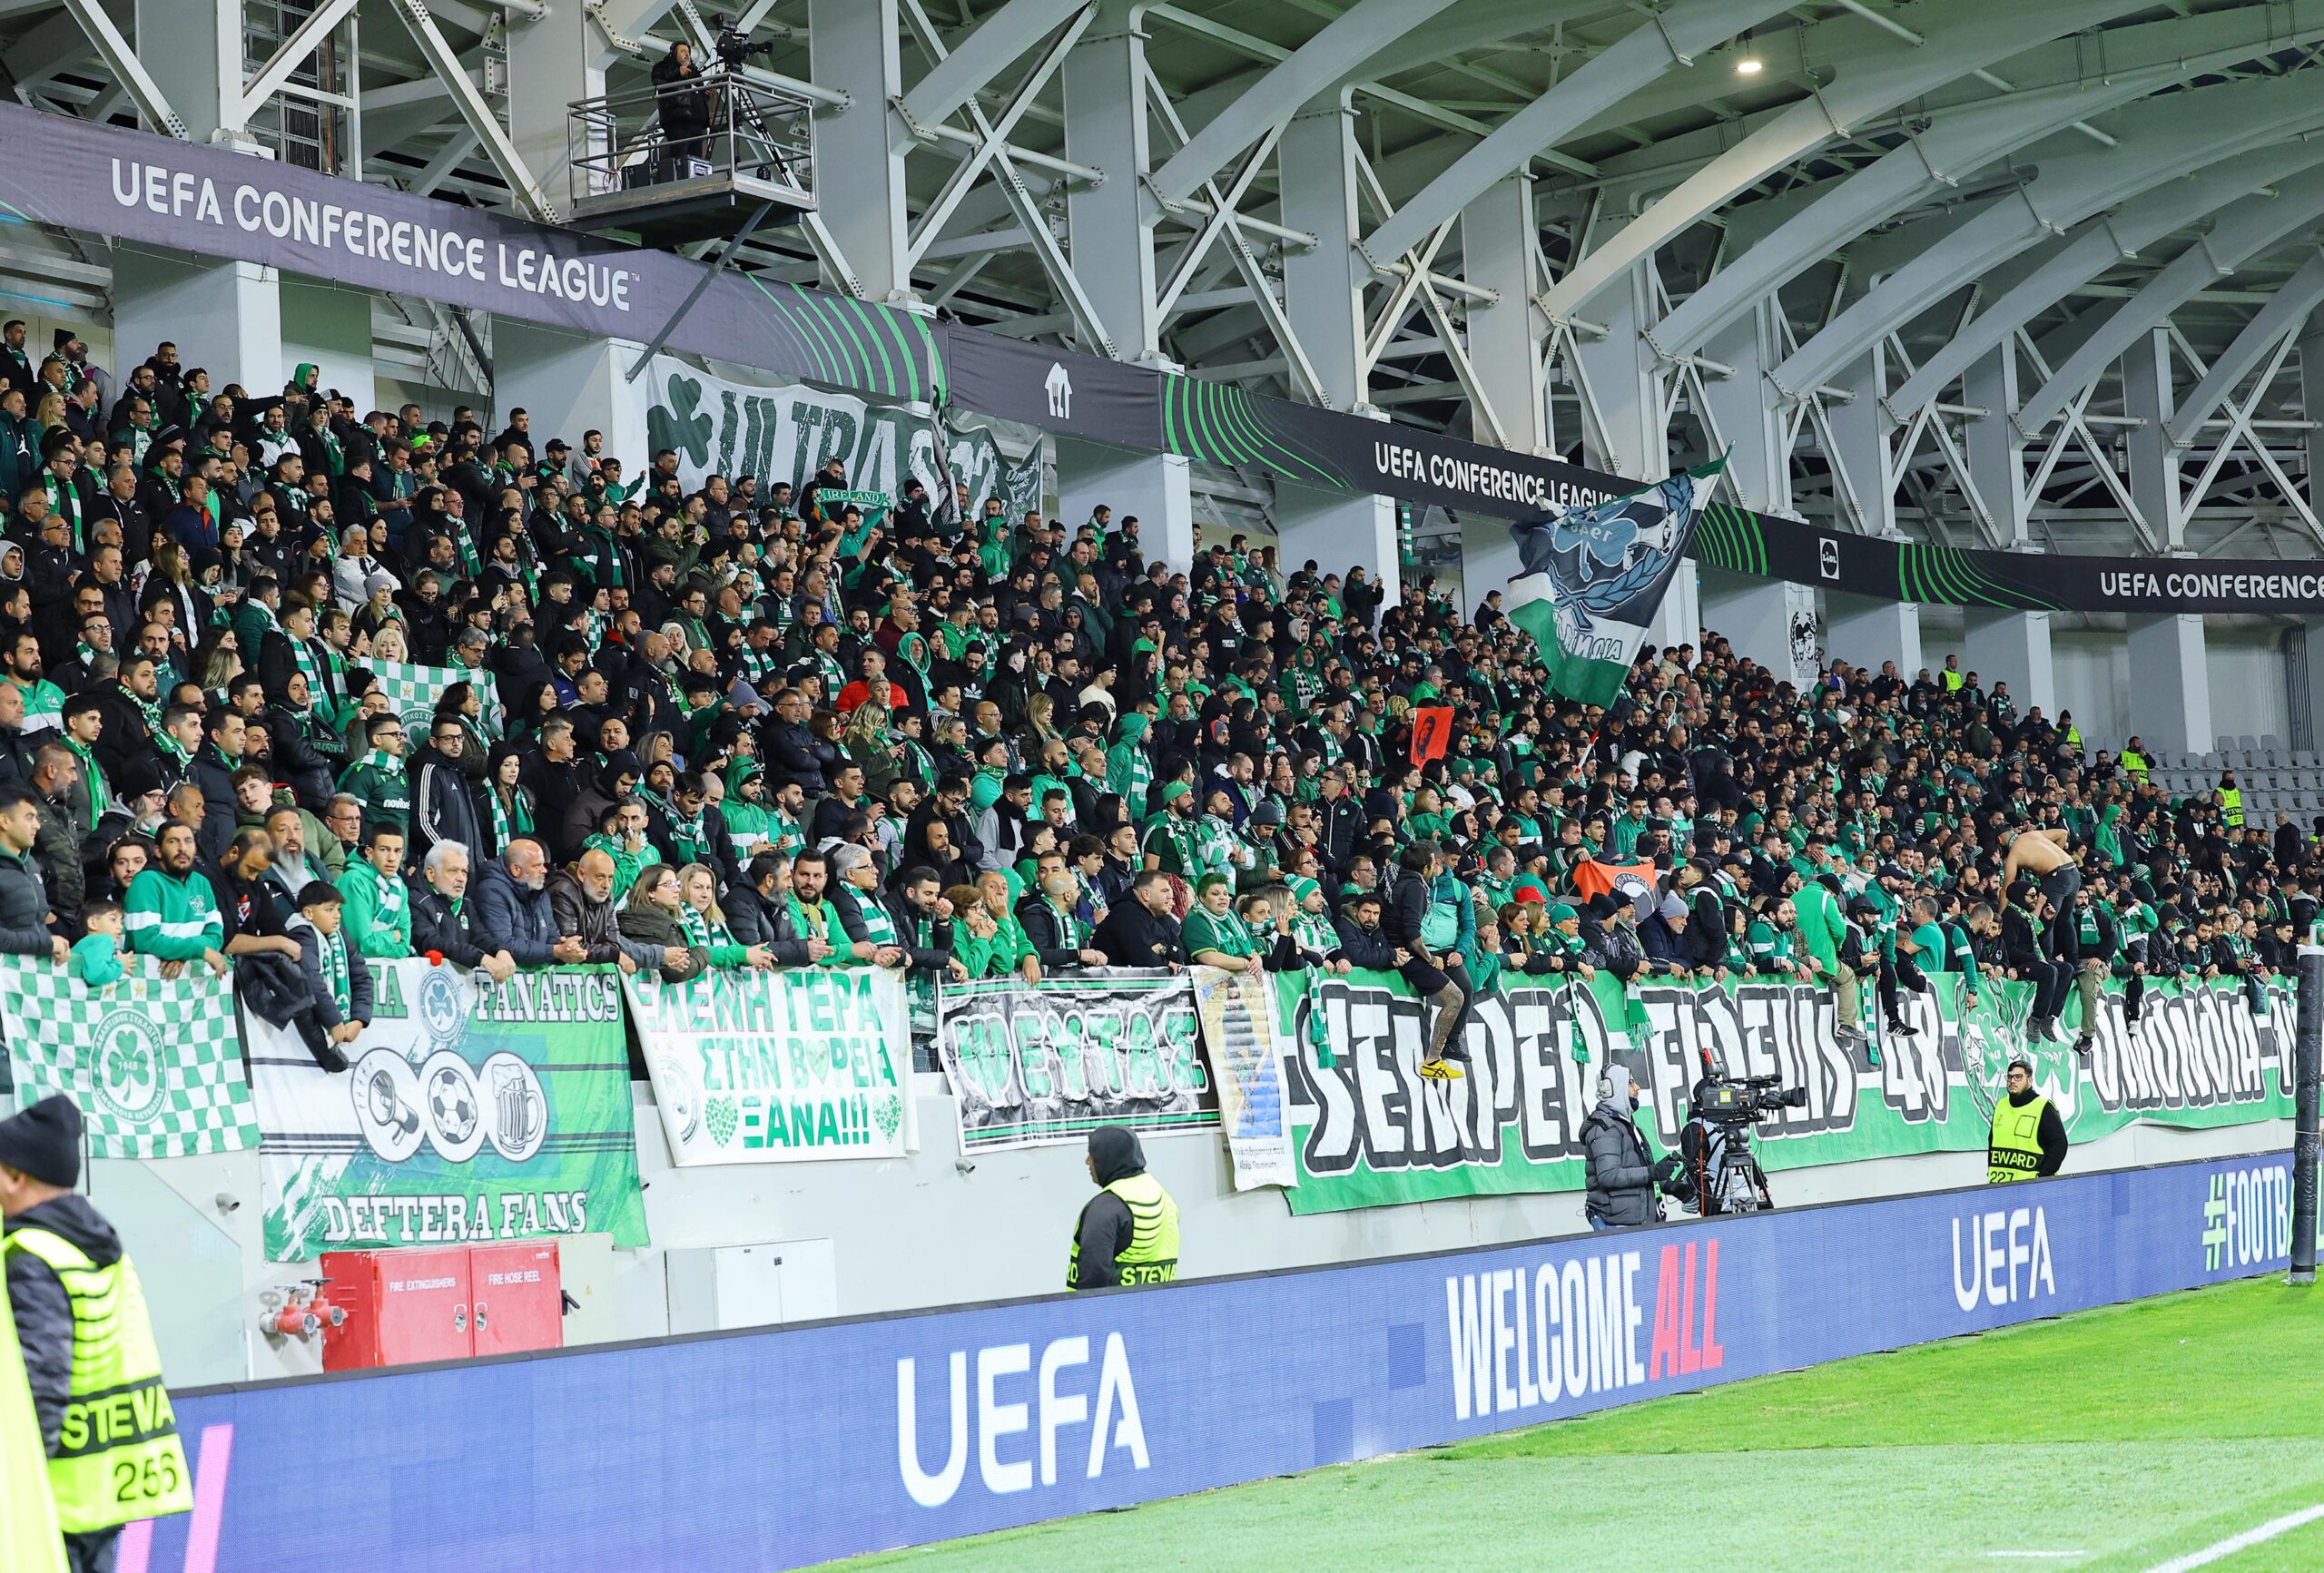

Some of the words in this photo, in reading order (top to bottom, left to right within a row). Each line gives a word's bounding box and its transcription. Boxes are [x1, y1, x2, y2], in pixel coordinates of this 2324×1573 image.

[111, 158, 224, 225] UEFA
[233, 184, 486, 281] CONFERENCE
[827, 490, 880, 503] IRELAND
[1374, 441, 1426, 483] UEFA
[1430, 454, 1545, 505] CONFERENCE
[2101, 572, 2162, 597] UEFA
[475, 971, 619, 1023] FANATICS
[783, 970, 883, 1032] ΓΕΡΑ
[696, 1037, 782, 1090] ΣΤΗΝ
[742, 1092, 870, 1149] ΞΑΝΑ!!!
[322, 1194, 495, 1243] DEFTERA
[499, 1191, 588, 1235] FANS
[389, 1282, 405, 1293] FIRE
[406, 1277, 456, 1292] EXTINGUISHERS
[488, 1273, 503, 1286] FIRE
[504, 1272, 523, 1285] HOSE
[524, 1270, 541, 1283] REEL
[1952, 1205, 2056, 1312] UEFA
[1446, 1251, 1646, 1421] WELCOME
[1649, 1238, 1724, 1381] ALL
[897, 1331, 1150, 1508] UEFA
